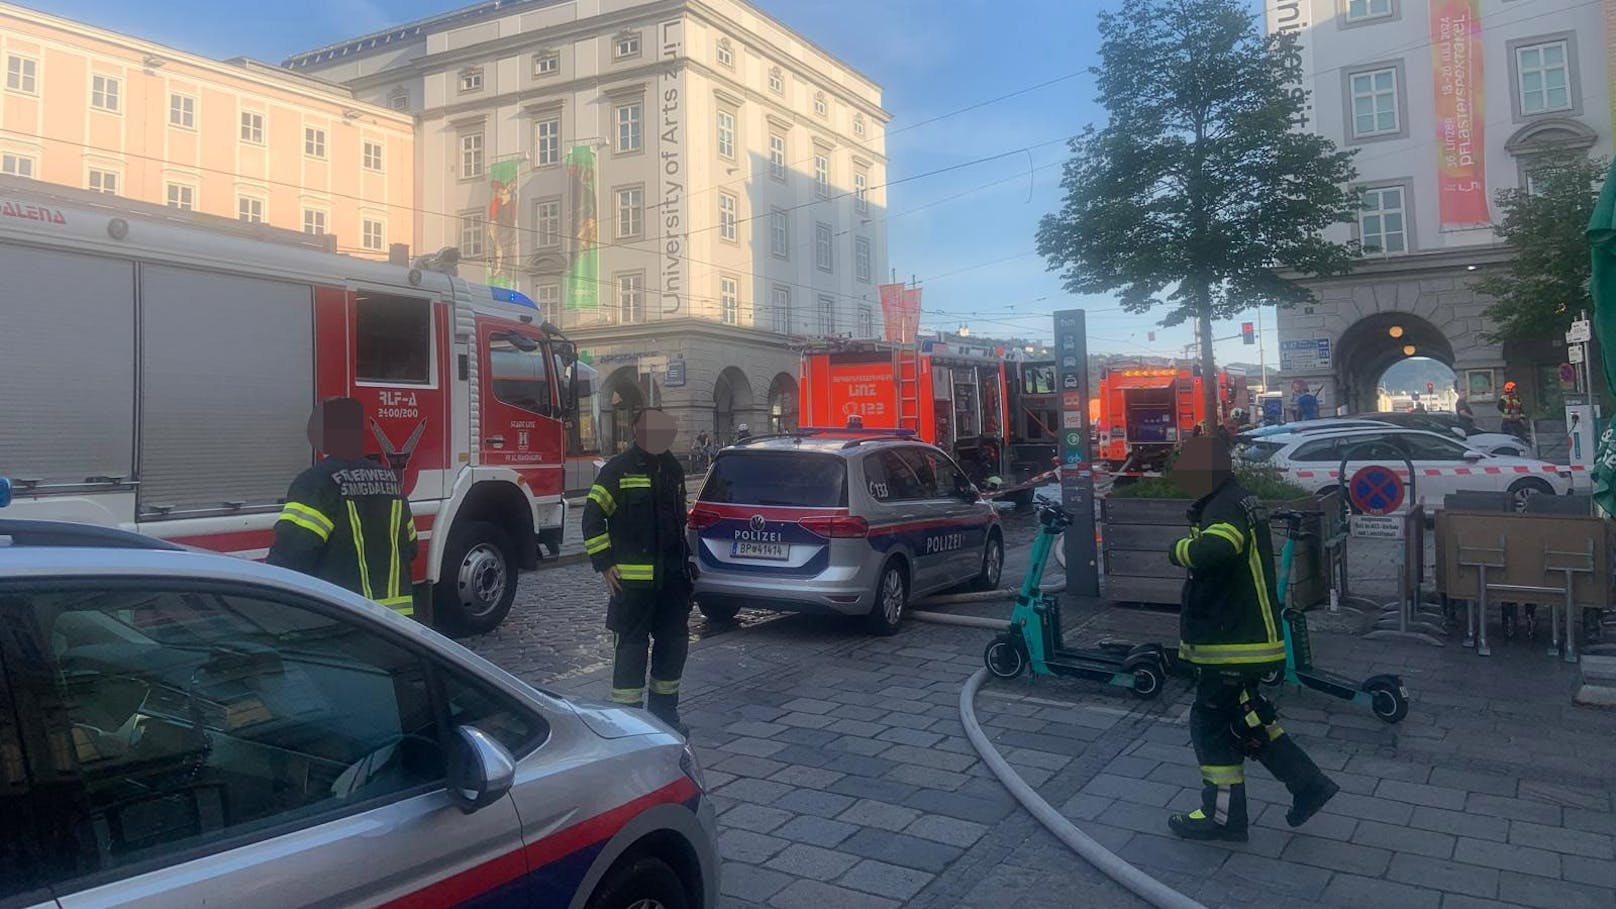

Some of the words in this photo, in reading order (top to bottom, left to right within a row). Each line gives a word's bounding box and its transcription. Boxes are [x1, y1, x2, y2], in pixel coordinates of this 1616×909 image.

[1440, 16, 1450, 40] 2024
[661, 88, 678, 144] Arts
[661, 151, 679, 175] of
[0, 201, 66, 225] ALENA
[662, 181, 683, 314] University
[378, 408, 418, 418] 2400/200
[861, 402, 885, 415] 122
[875, 482, 889, 498] 133
[734, 529, 782, 542] POLIZEI
[927, 534, 962, 554] POLIZEI
